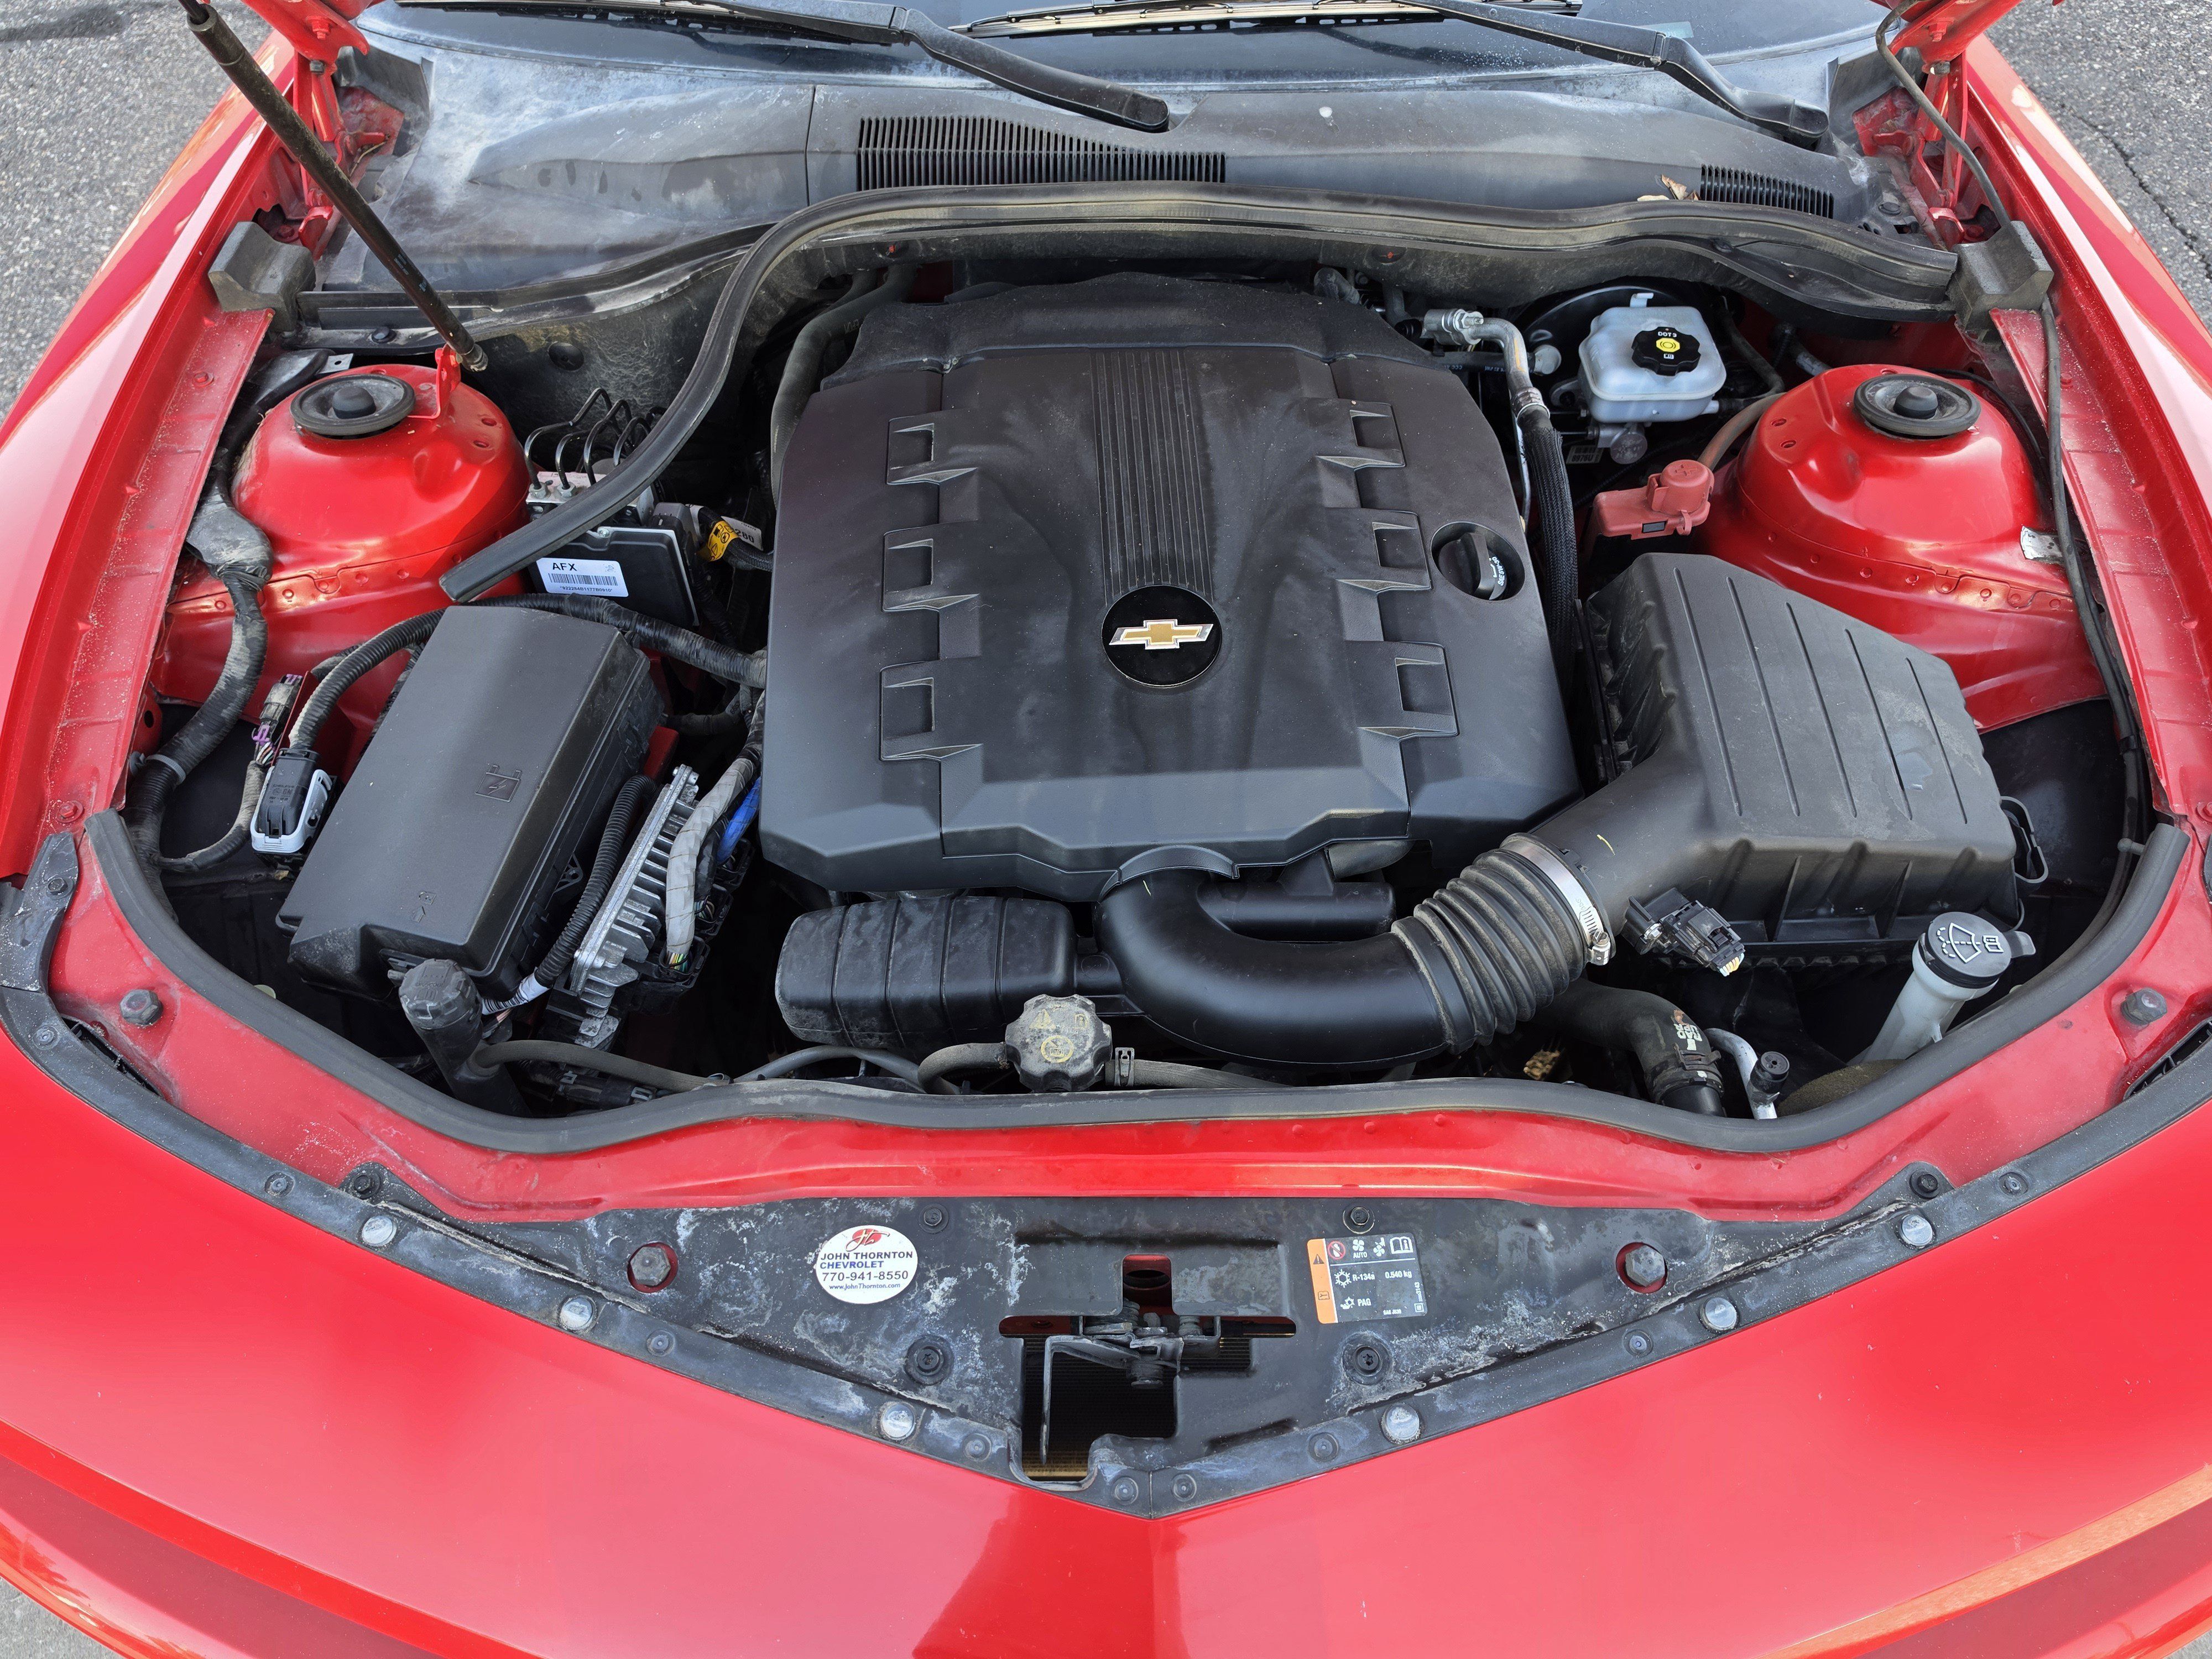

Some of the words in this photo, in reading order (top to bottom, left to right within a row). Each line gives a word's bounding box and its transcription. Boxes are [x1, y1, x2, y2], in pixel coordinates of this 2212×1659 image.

[552, 562, 577, 571] AFX
[821, 1252, 850, 1260] JOHN
[854, 1251, 913, 1260] THORNTON
[820, 1261, 884, 1269] CHEVROLET
[822, 1270, 909, 1281] 770-941-8550
[1352, 1273, 1375, 1281] R-134a
[1384, 1271, 1402, 1279] 0.540
[1403, 1270, 1412, 1279] kg
[829, 1282, 901, 1291] www.JohnThornton.com
[1358, 1298, 1371, 1307] PAG
